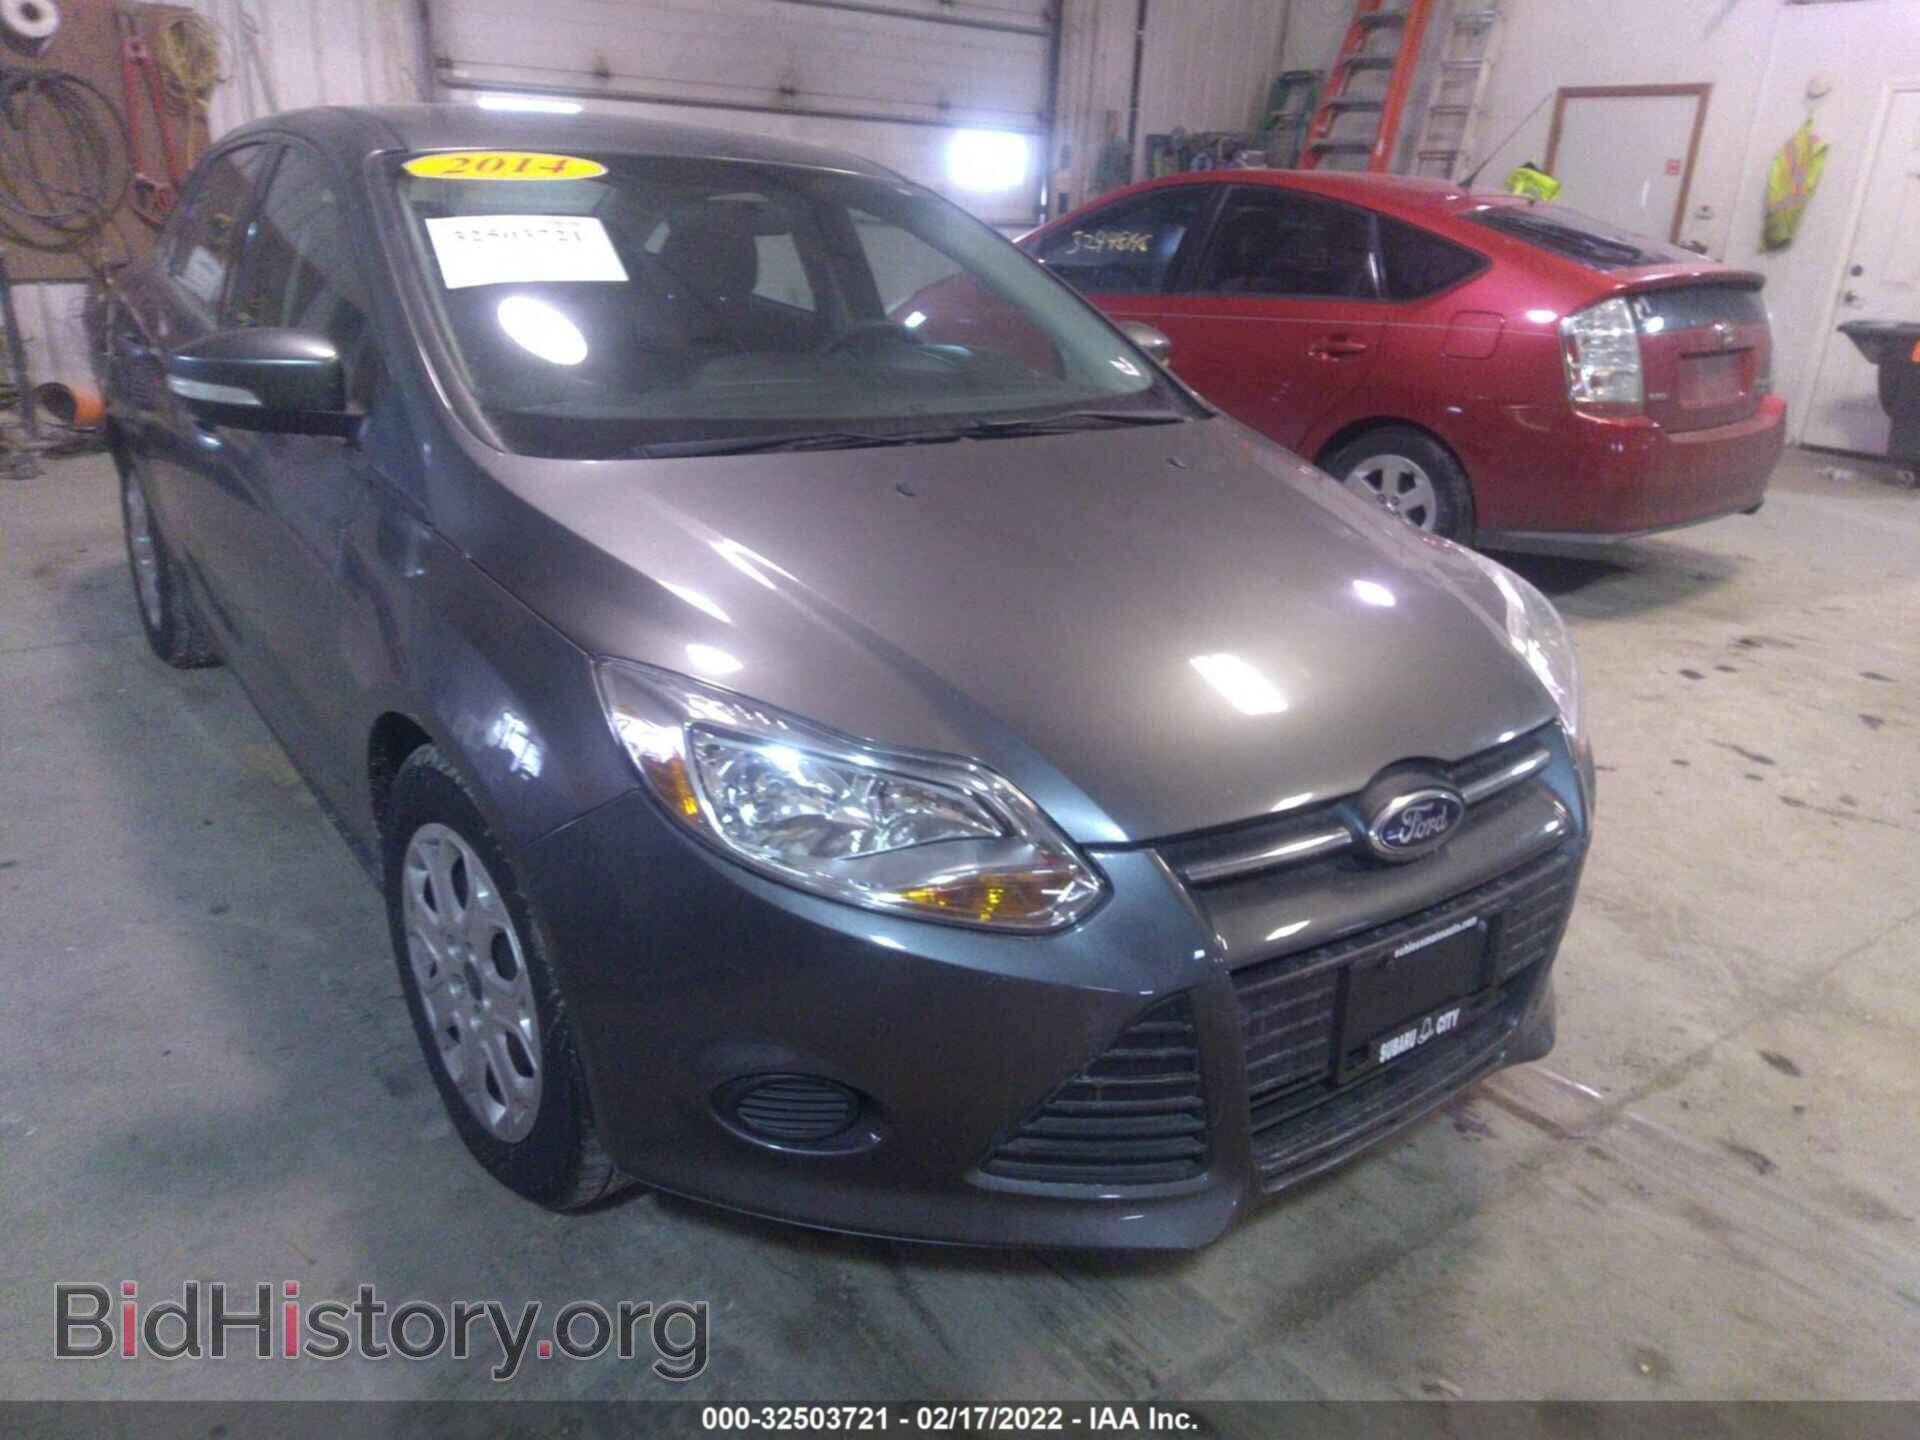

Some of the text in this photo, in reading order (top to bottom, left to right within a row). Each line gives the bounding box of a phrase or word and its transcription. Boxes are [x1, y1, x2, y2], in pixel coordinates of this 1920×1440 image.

[442, 157, 568, 175] 2014
[1386, 802, 1448, 843] Ford
[1436, 1008, 1461, 1034] CITY
